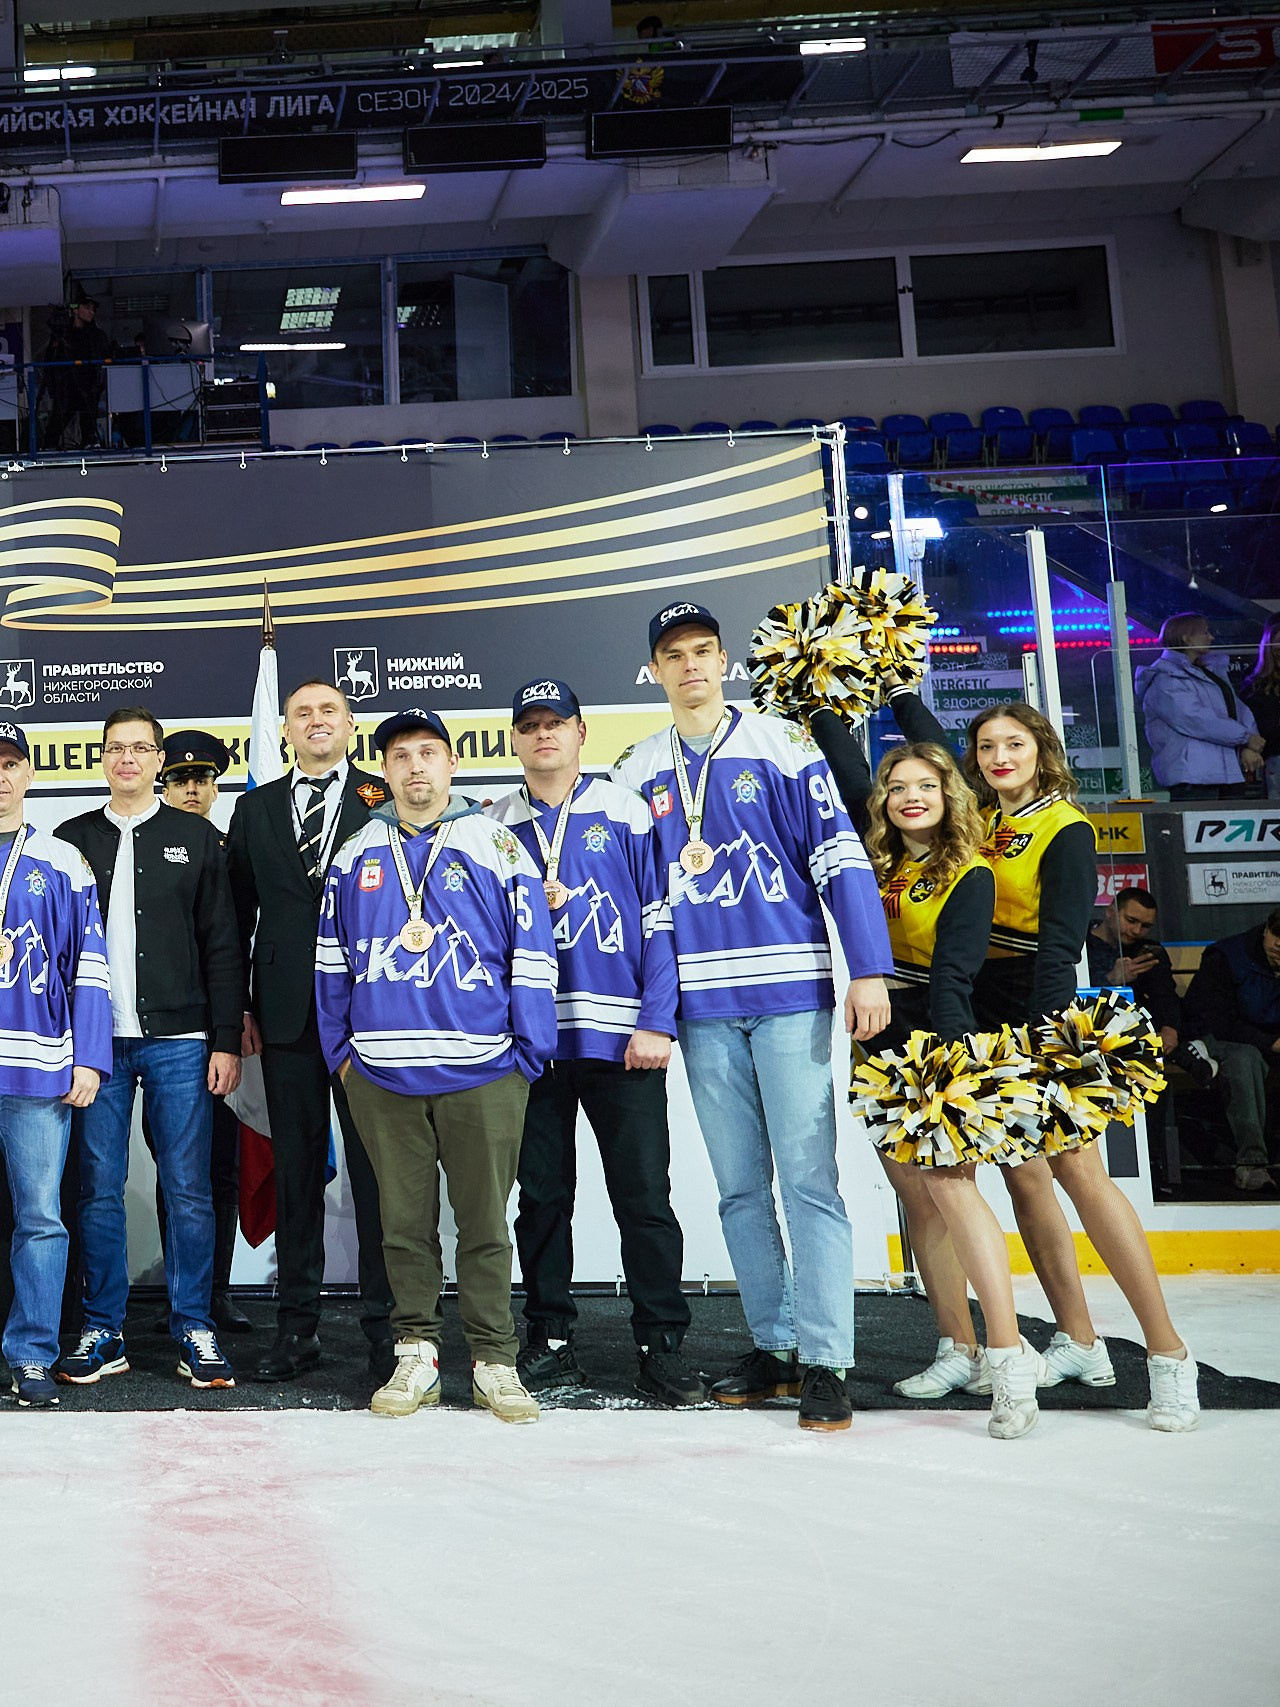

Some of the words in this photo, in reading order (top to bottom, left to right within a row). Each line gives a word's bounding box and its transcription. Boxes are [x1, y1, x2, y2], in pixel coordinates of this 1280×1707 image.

[104, 95, 256, 128] ХОККЕЙНАЯ
[265, 94, 336, 118] ЛИГА
[357, 87, 439, 114] СЕЗОН
[448, 78, 589, 107] 2024/2025
[42, 661, 165, 677] ПРАВИТЕЛЬСТВО
[387, 652, 464, 672] НИЖНИЙ
[43, 676, 153, 692] НИЖЕГОРОДСКОЙ
[387, 673, 482, 690] НОВГОРОД
[43, 692, 100, 704] ОБЛАСТИ
[456, 729, 518, 759] ЛИ
